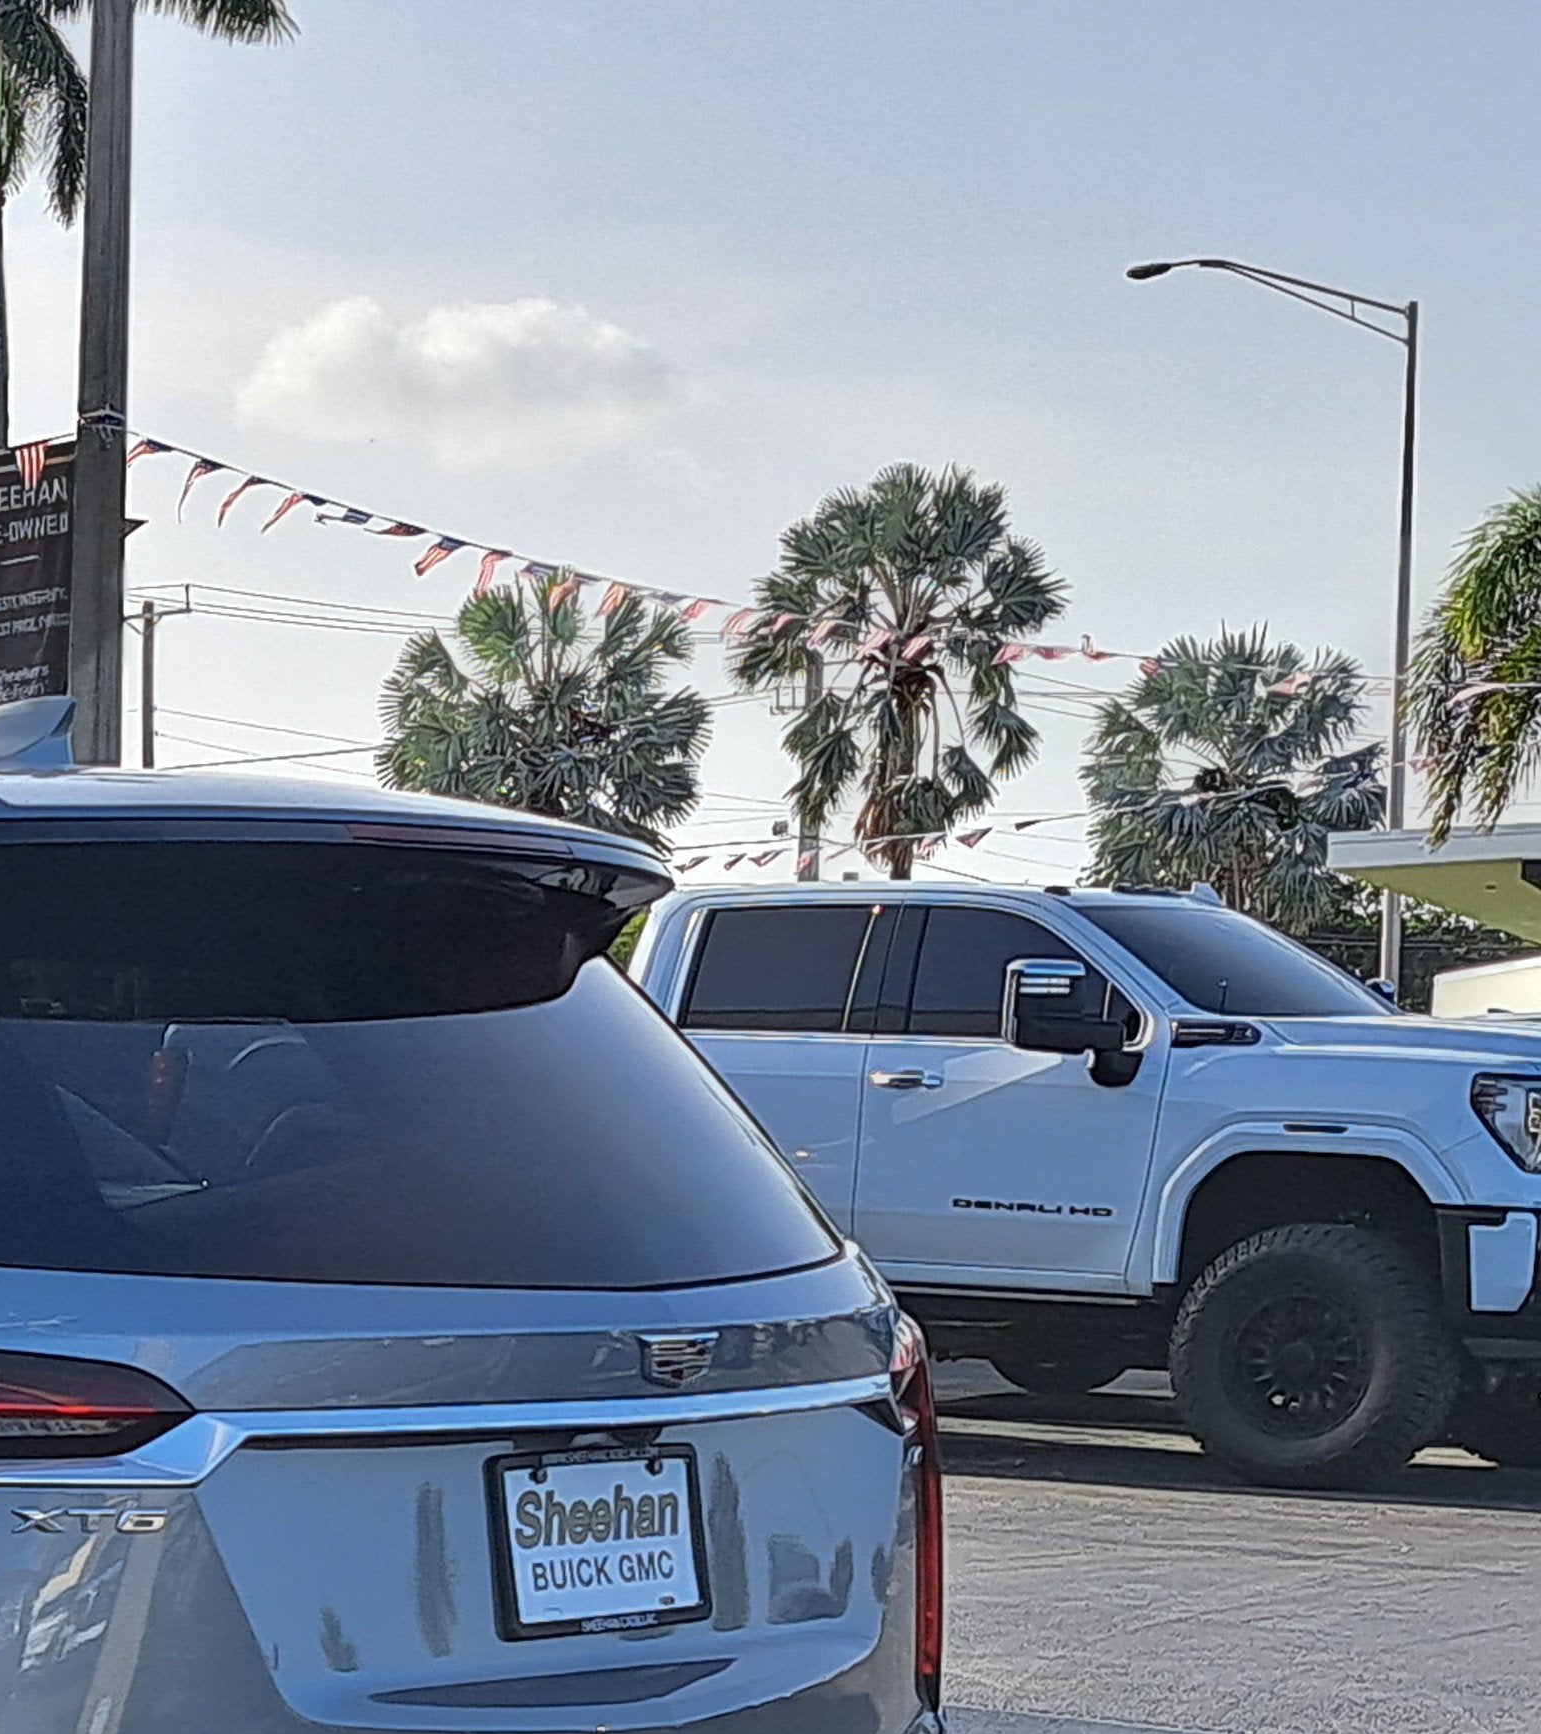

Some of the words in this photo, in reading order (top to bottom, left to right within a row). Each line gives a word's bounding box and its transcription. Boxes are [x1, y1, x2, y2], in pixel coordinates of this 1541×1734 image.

[953, 1199, 1062, 1213] DENALI
[1069, 1207, 1113, 1217] HD
[11, 1507, 168, 1534] XT6
[515, 1484, 679, 1549] Sheehan
[532, 1554, 614, 1591] BUICK
[618, 1550, 674, 1583] GMC
